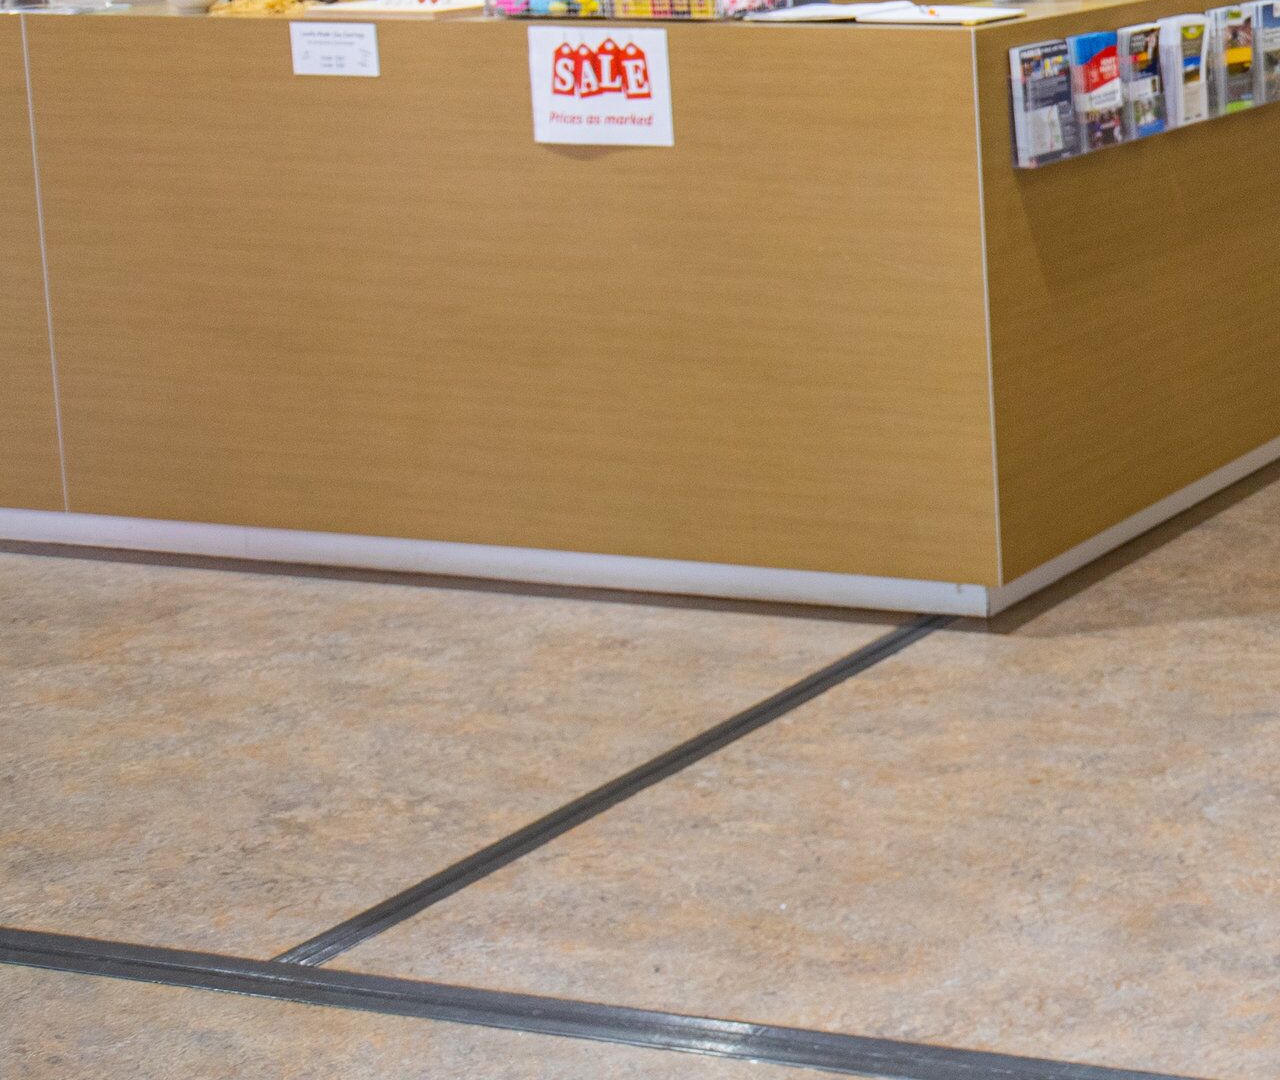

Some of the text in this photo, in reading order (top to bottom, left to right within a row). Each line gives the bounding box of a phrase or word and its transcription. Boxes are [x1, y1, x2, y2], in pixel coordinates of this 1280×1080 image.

[554, 54, 650, 94] SALE
[549, 110, 653, 127] Prices as marked
